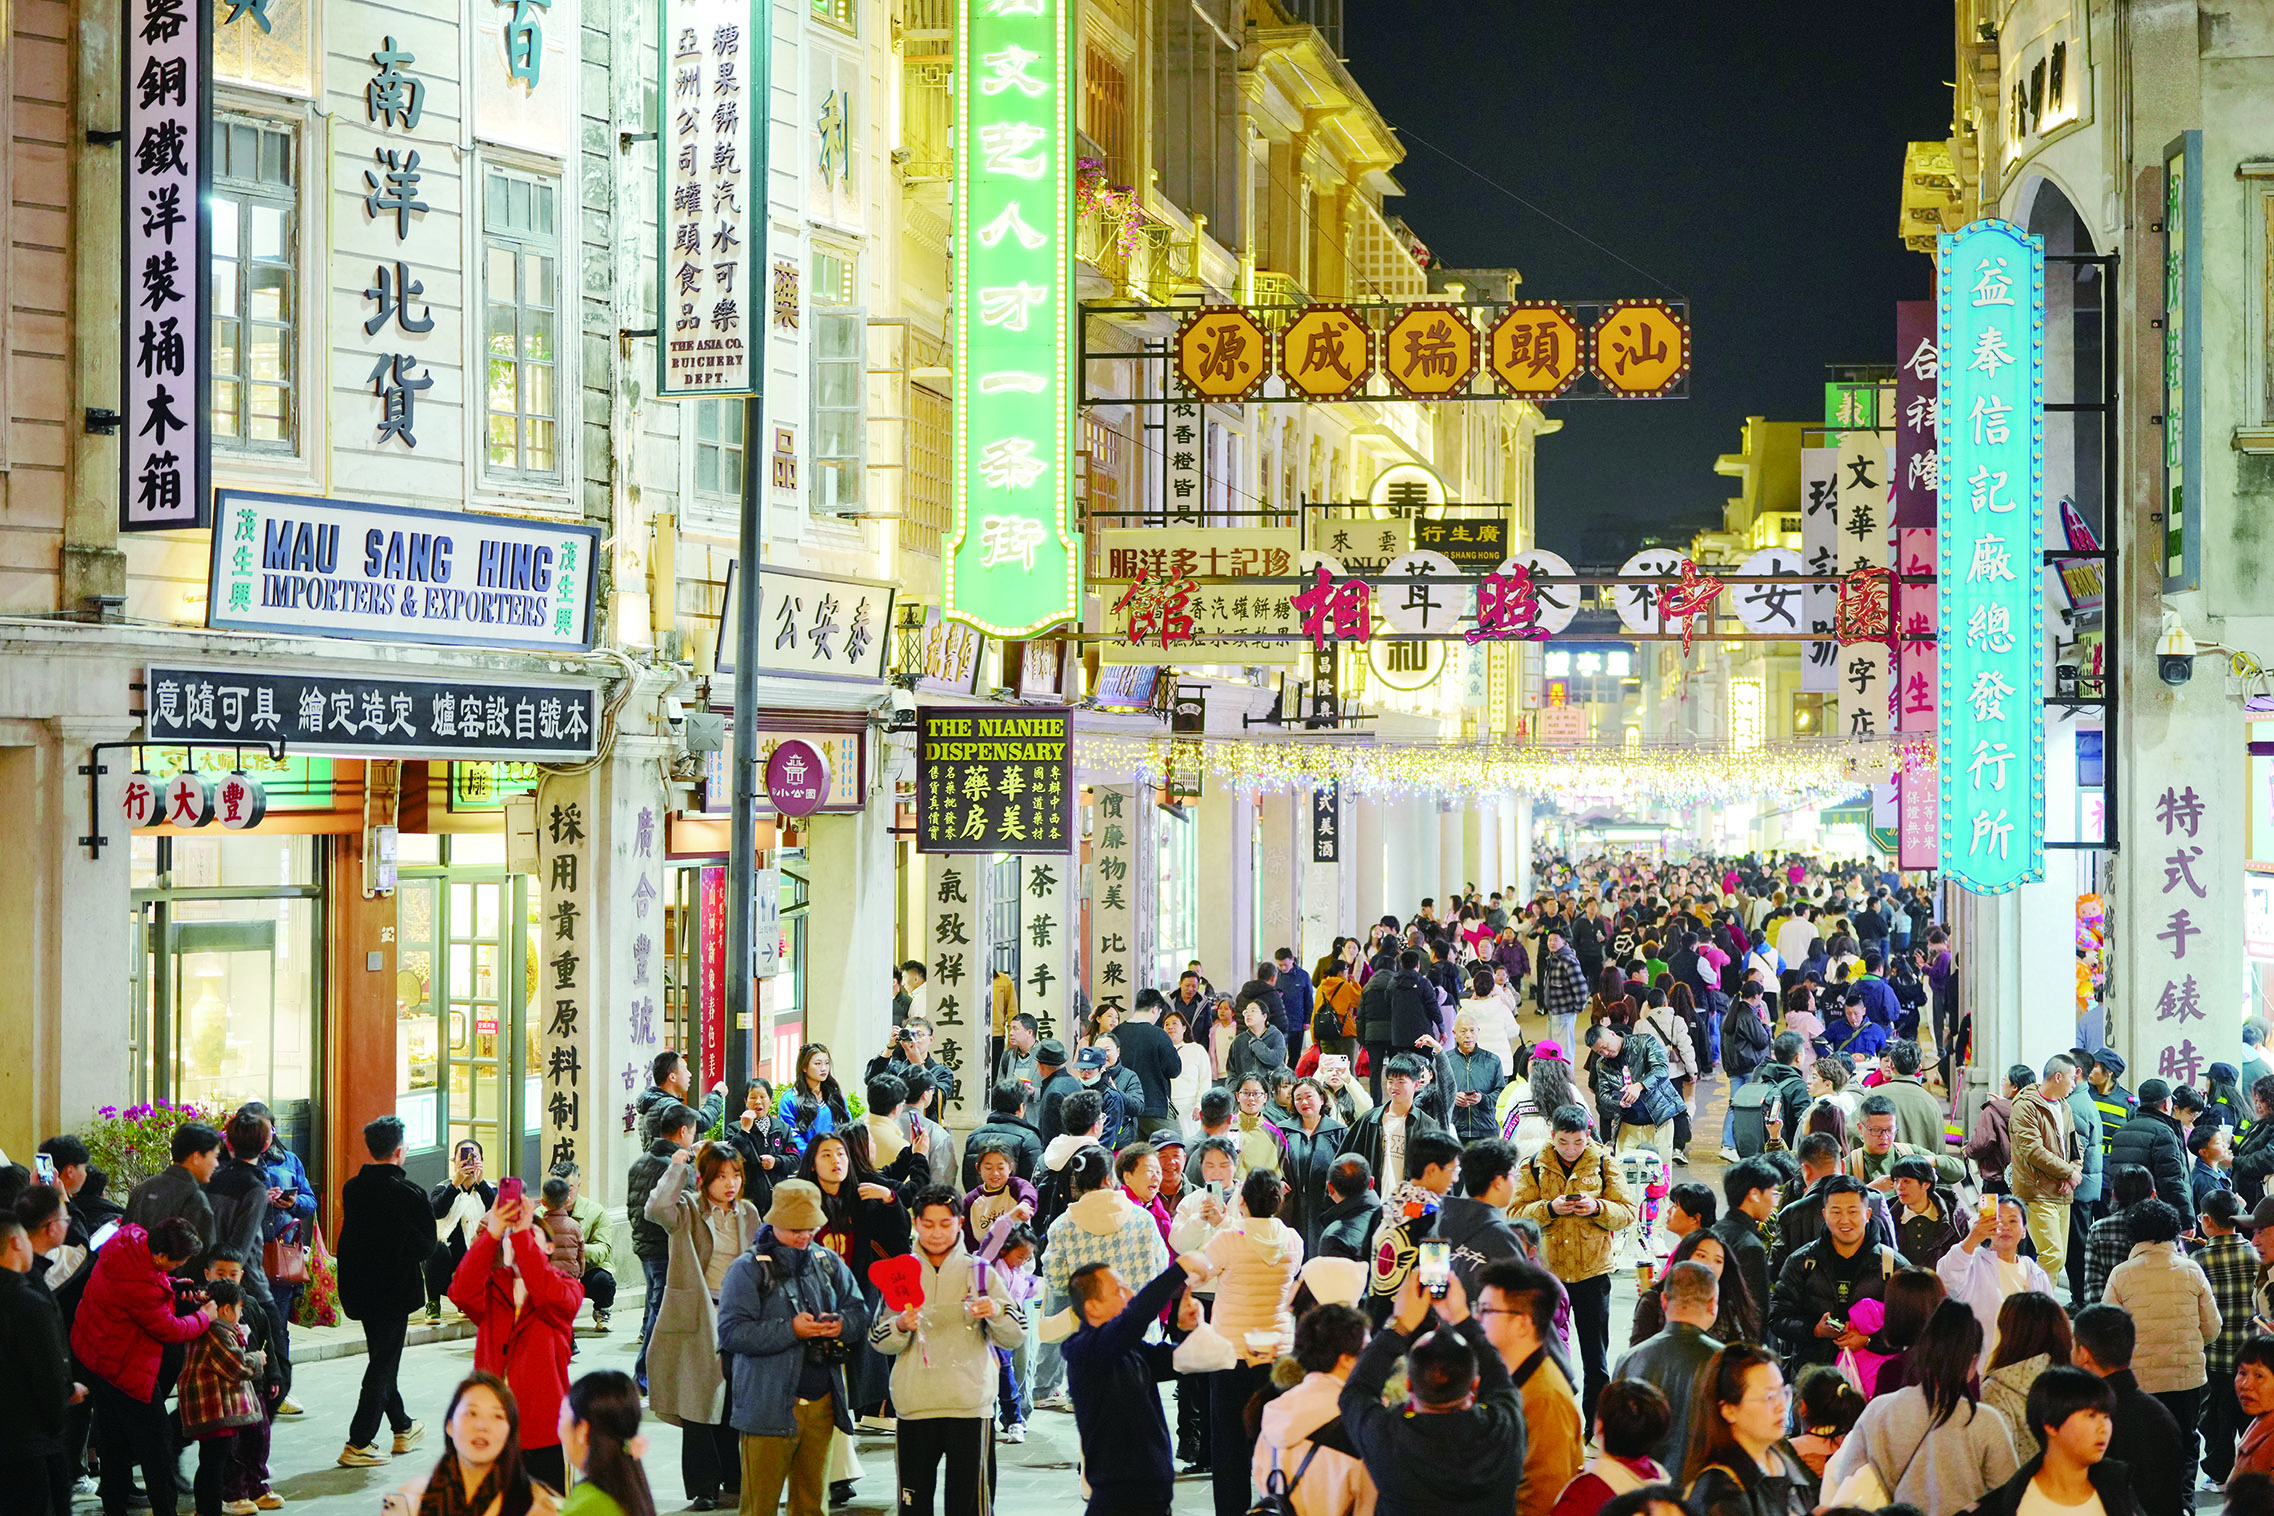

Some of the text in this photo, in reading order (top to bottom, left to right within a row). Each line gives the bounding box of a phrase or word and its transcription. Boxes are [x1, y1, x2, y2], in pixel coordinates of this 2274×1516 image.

[364, 35, 435, 448] 南洋北貨
[670, 338, 744, 352] THE ASIA CO.
[684, 372, 728, 384] DEPT.
[229, 509, 258, 613] 茂生興
[262, 518, 554, 593] MAU SANG HING
[1451, 551, 1476, 559] SHANG
[1478, 551, 1500, 559] HONG
[1966, 257, 2018, 861] 益奉信記廠總發行所
[261, 573, 547, 628] IMPORTERS & EXPORTERS
[554, 541, 579, 636] 茂生興
[759, 586, 874, 664] 泰安公
[925, 743, 1066, 761] DISPENSARY
[926, 719, 1064, 737] THE NIANHE
